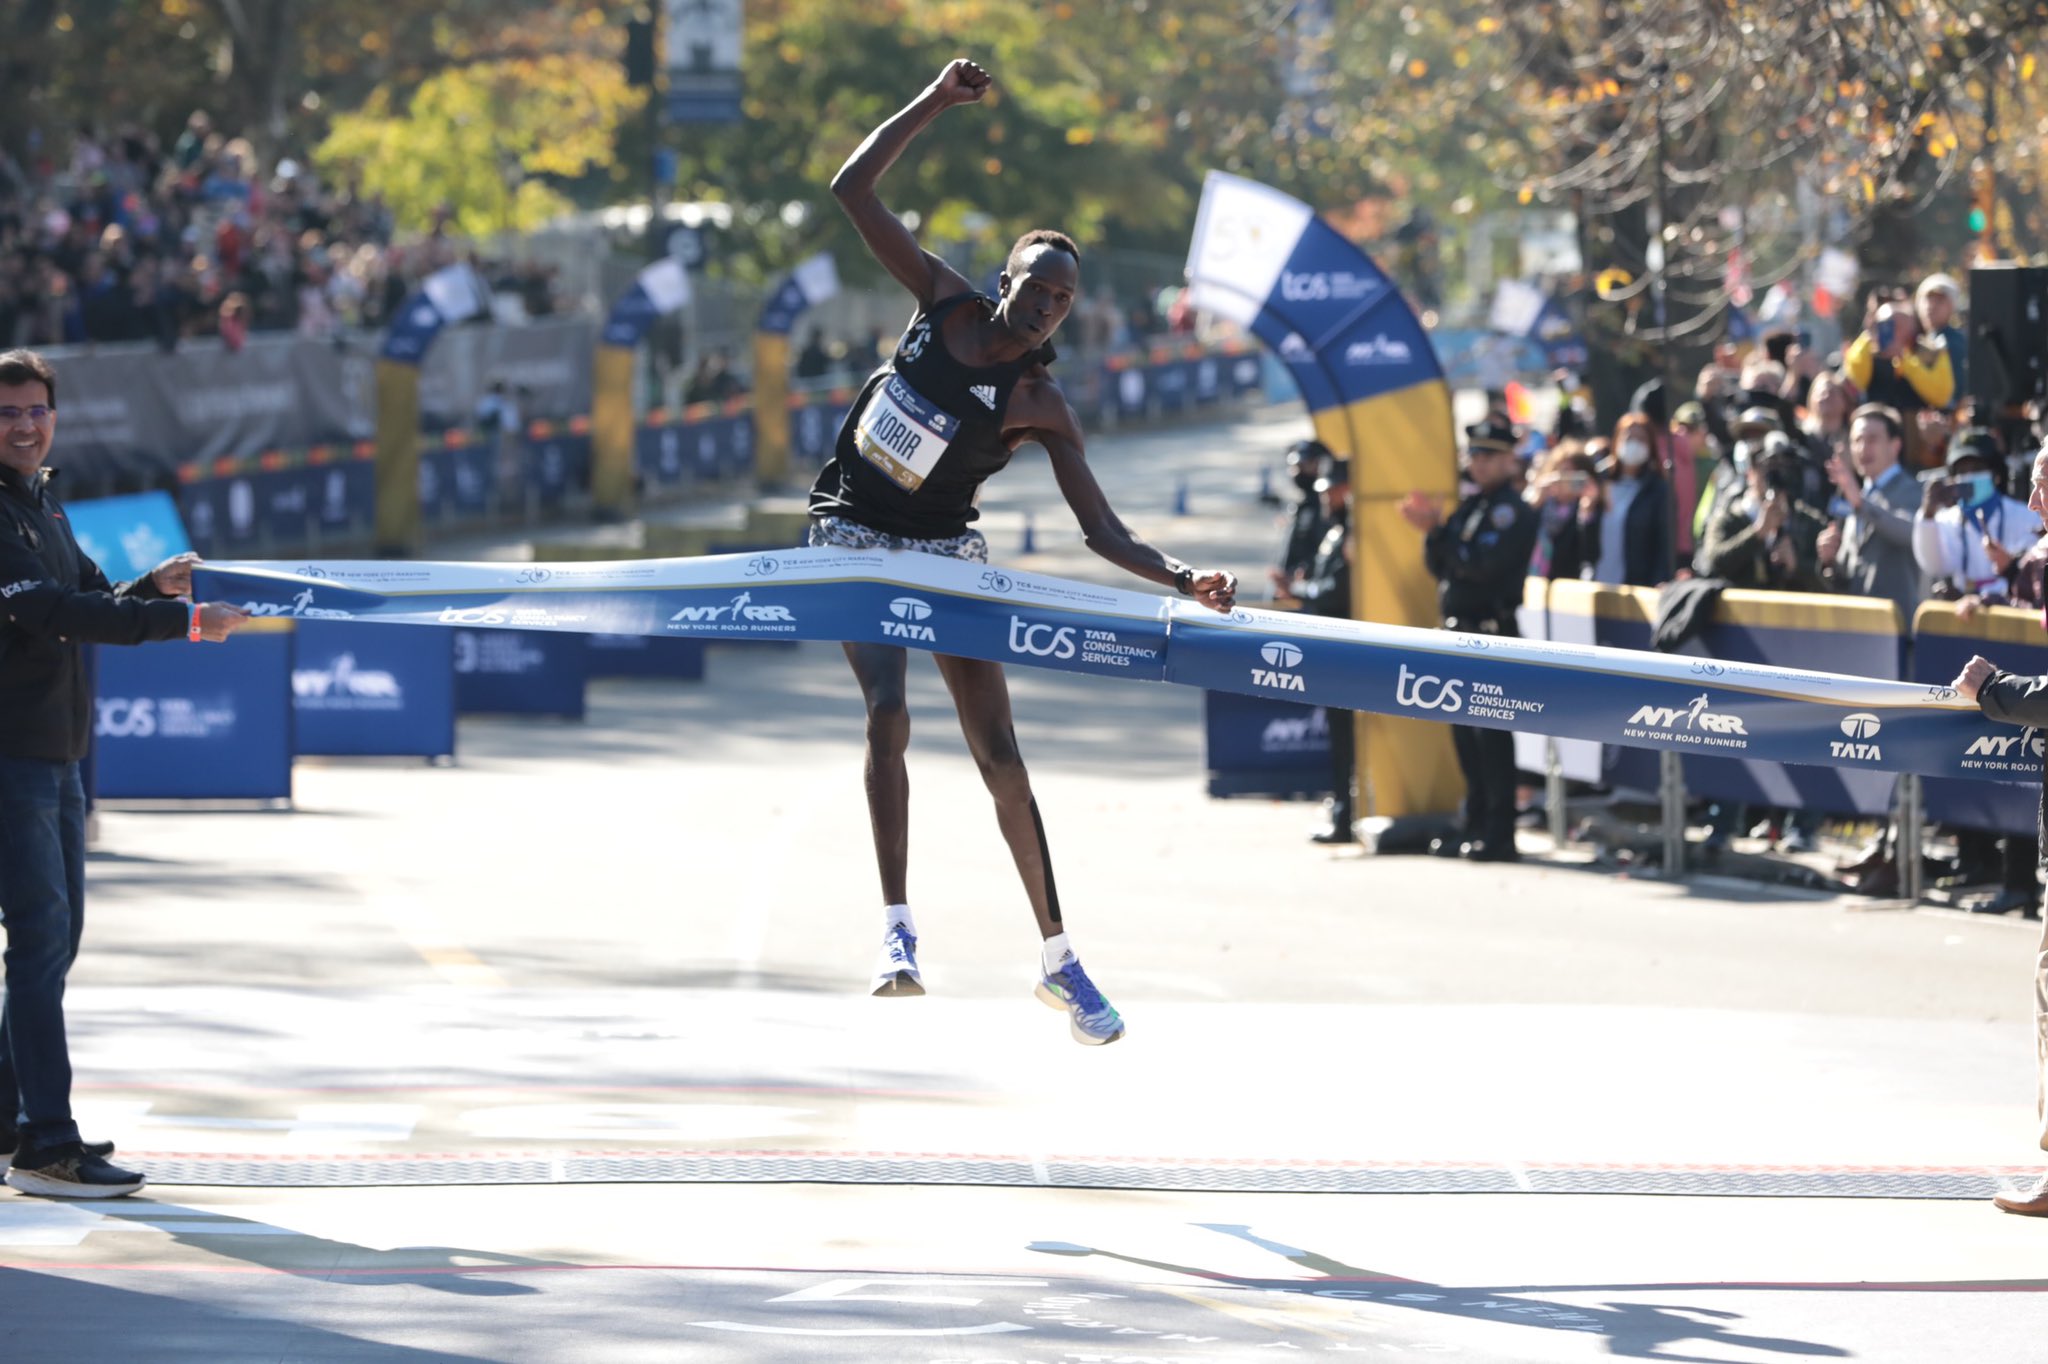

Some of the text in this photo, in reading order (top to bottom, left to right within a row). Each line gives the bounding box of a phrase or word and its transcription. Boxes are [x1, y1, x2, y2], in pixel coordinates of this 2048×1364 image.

[873, 409, 922, 461] KORIR
[437, 606, 509, 625] tcs
[667, 623, 690, 631] NEW
[692, 623, 718, 631] YORK
[720, 624, 748, 632] ROAD
[880, 621, 936, 642] TATA
[1009, 615, 1076, 659] tcs
[1083, 629, 1116, 642] TATA
[1081, 651, 1130, 666] SERVICES
[1082, 640, 1157, 659] CONSULTANCY
[1251, 668, 1305, 692] TATA
[1396, 664, 1464, 712] tcs
[1472, 682, 1503, 695] TATA
[1467, 705, 1515, 720] SERVICES
[1469, 694, 1544, 713] CONSULTANCY
[1627, 704, 1748, 735] NYRR
[1623, 728, 1747, 748] NEW YORK ROAD RUNNERS
[1830, 741, 1881, 761] TATA
[1961, 760, 1982, 768] NEW
[1985, 761, 2008, 770] YORK
[2011, 763, 2038, 772] ROAD
